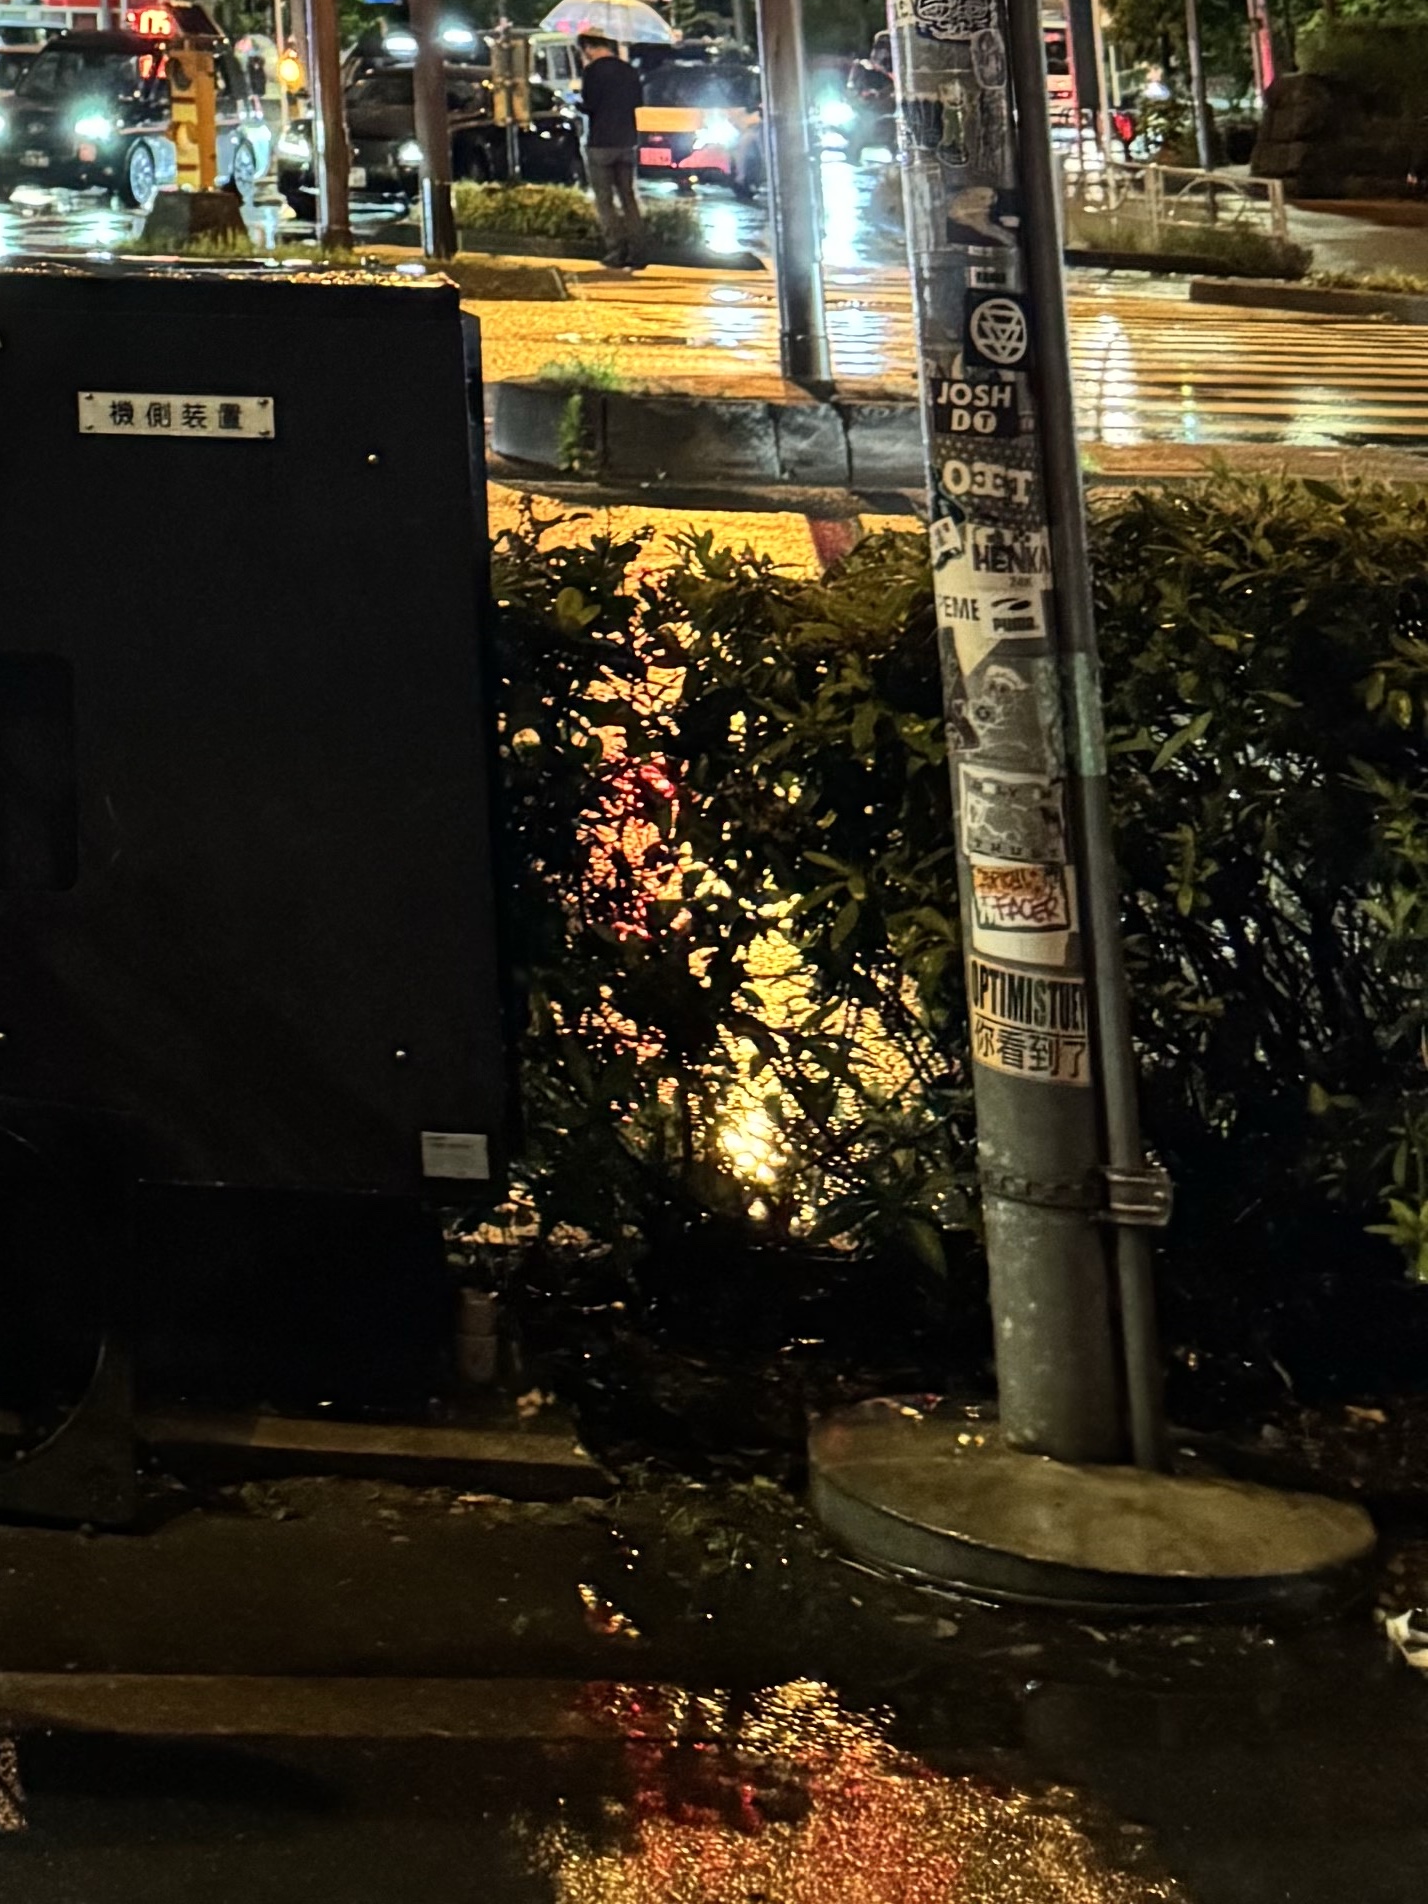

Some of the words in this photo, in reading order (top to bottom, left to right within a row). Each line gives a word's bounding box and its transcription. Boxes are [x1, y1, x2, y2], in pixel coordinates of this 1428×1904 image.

[937, 382, 1012, 408] JOSH
[109, 400, 243, 430] 機側装置
[975, 1019, 1086, 1078] 你看到了
